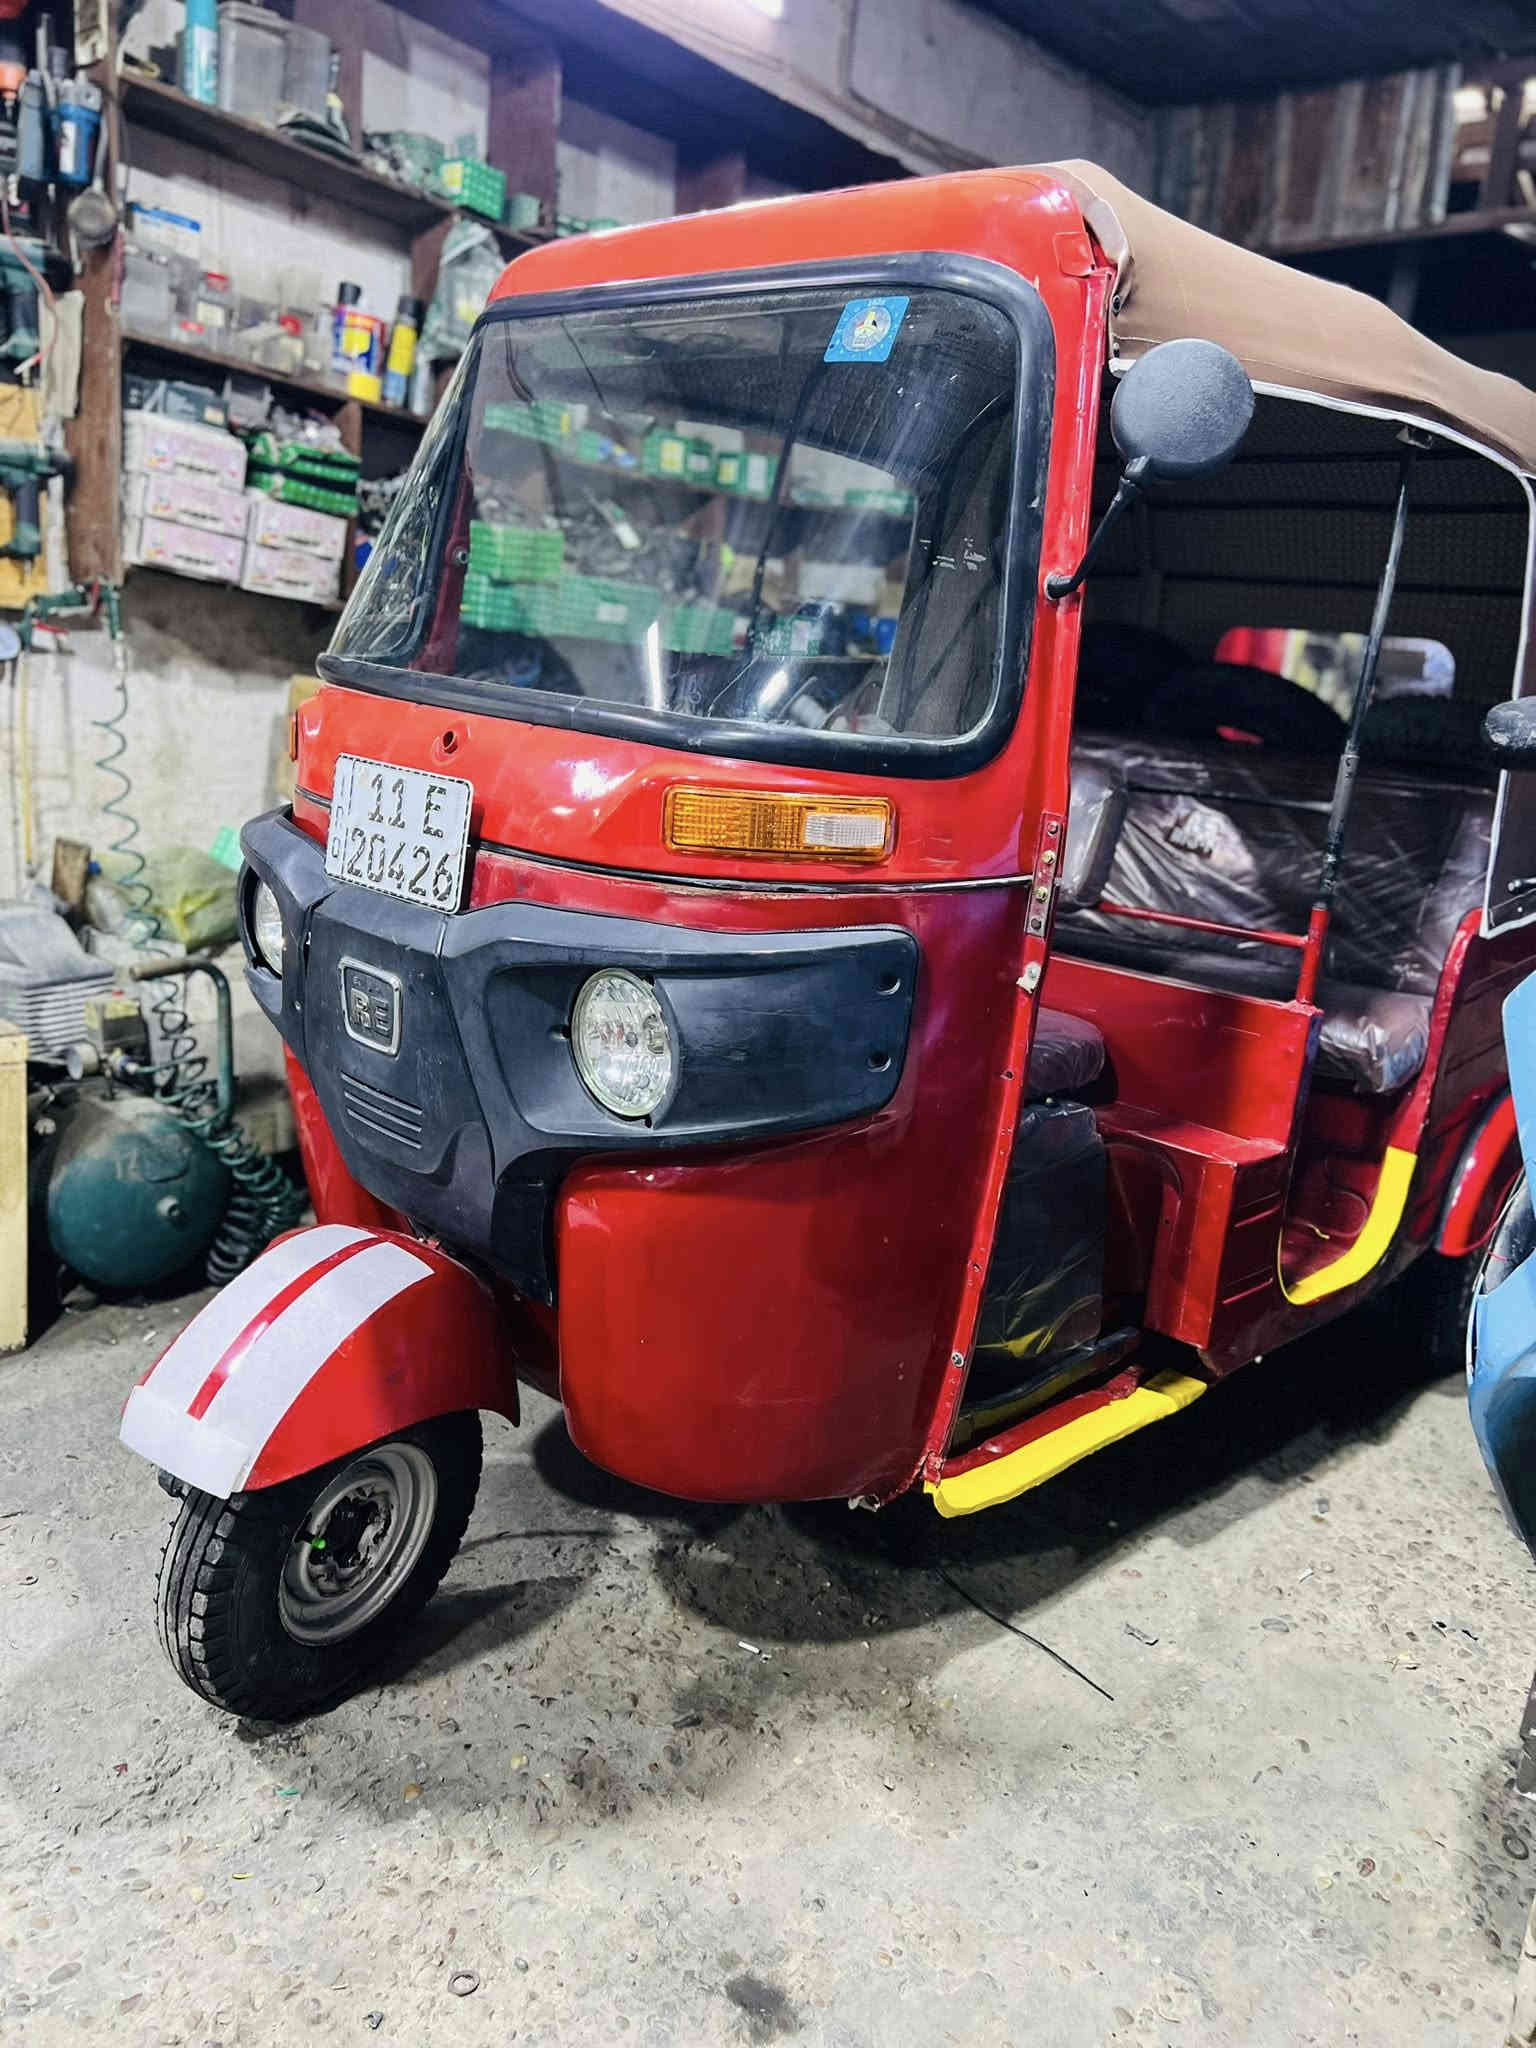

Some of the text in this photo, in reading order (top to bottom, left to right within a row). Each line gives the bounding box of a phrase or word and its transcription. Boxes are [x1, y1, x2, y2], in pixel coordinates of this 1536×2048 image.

[368, 773, 447, 839] 11 E
[347, 827, 453, 902] 20426
[350, 988, 390, 1032] RE
